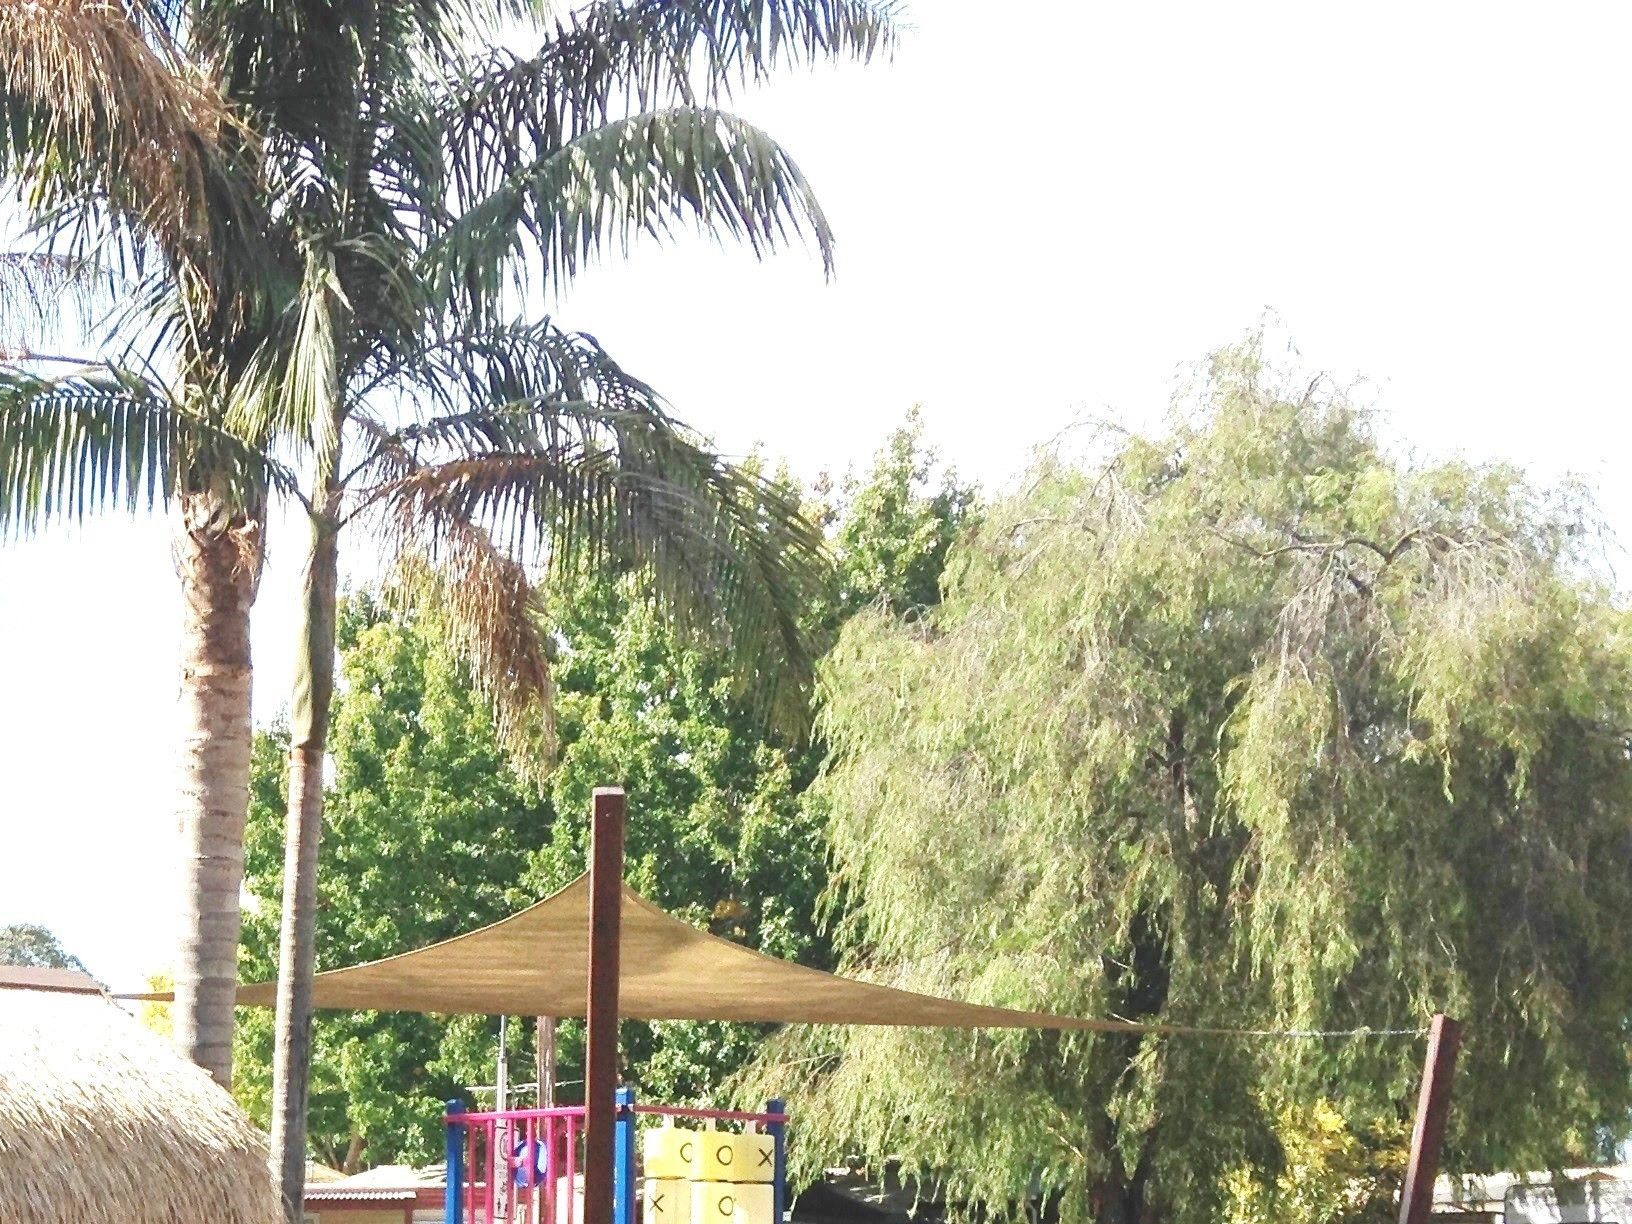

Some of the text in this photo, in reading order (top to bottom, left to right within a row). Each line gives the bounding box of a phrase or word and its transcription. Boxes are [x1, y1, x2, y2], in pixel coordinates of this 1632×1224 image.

[716, 1145, 733, 1166] O
[758, 1148, 773, 1167] X
[718, 1195, 734, 1216] O
